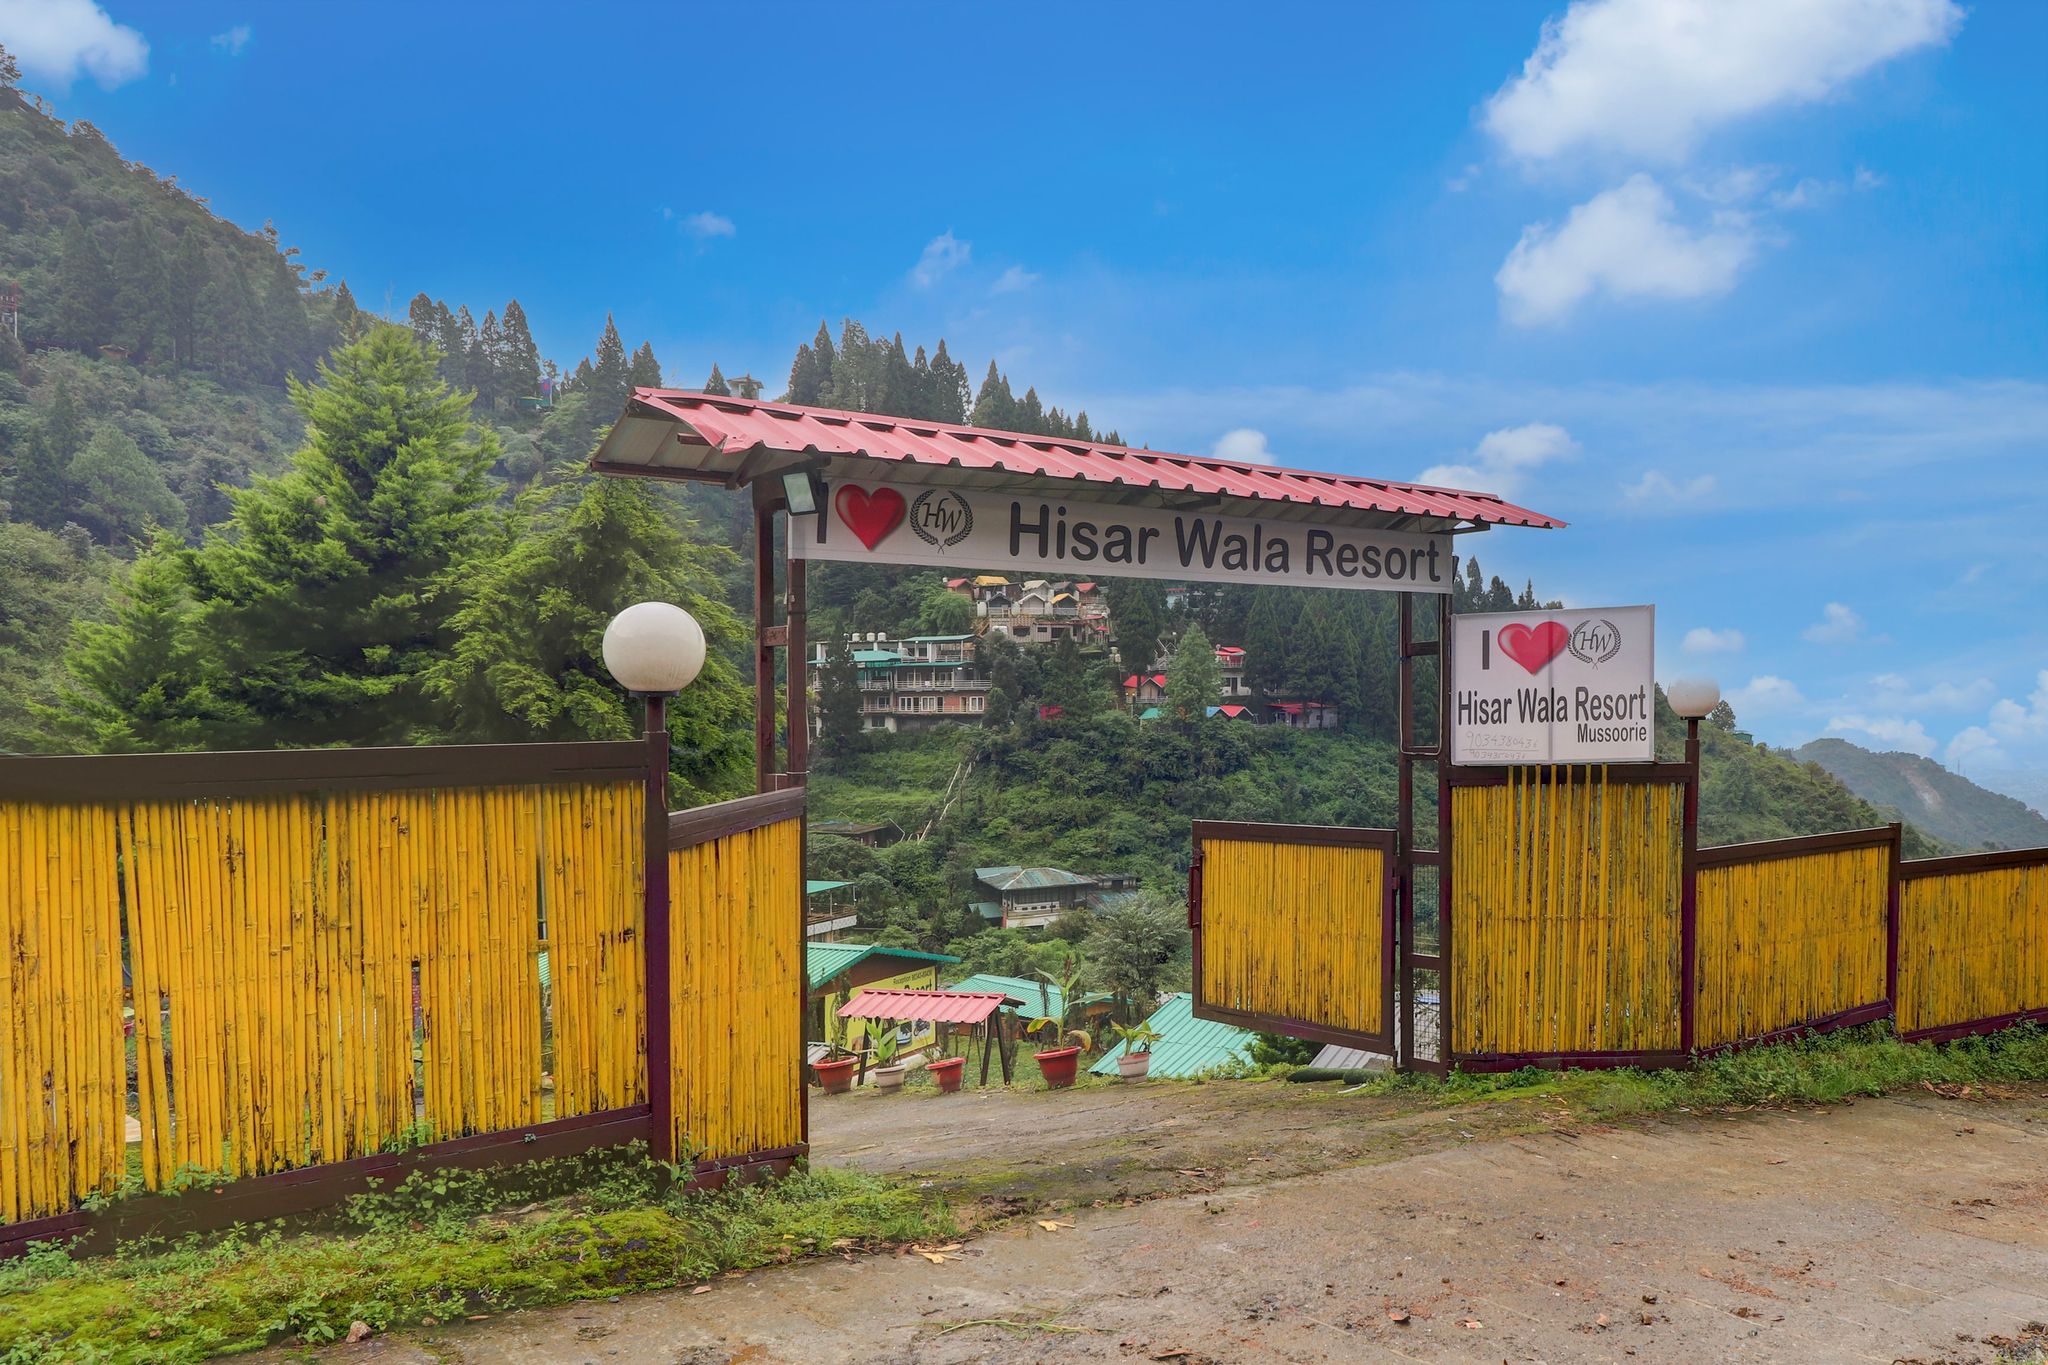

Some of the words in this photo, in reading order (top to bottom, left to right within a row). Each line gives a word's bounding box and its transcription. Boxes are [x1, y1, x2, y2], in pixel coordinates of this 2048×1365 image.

[816, 482, 829, 544] I
[1009, 501, 1160, 566] Hisar
[1174, 516, 1290, 573] Wala
[1305, 529, 1441, 582] Resort
[1482, 630, 1490, 670] I
[1458, 690, 1512, 725] Hisar
[1517, 687, 1568, 724] Wala
[1575, 685, 1647, 722] Resort
[1577, 722, 1647, 743] Mussoorie
